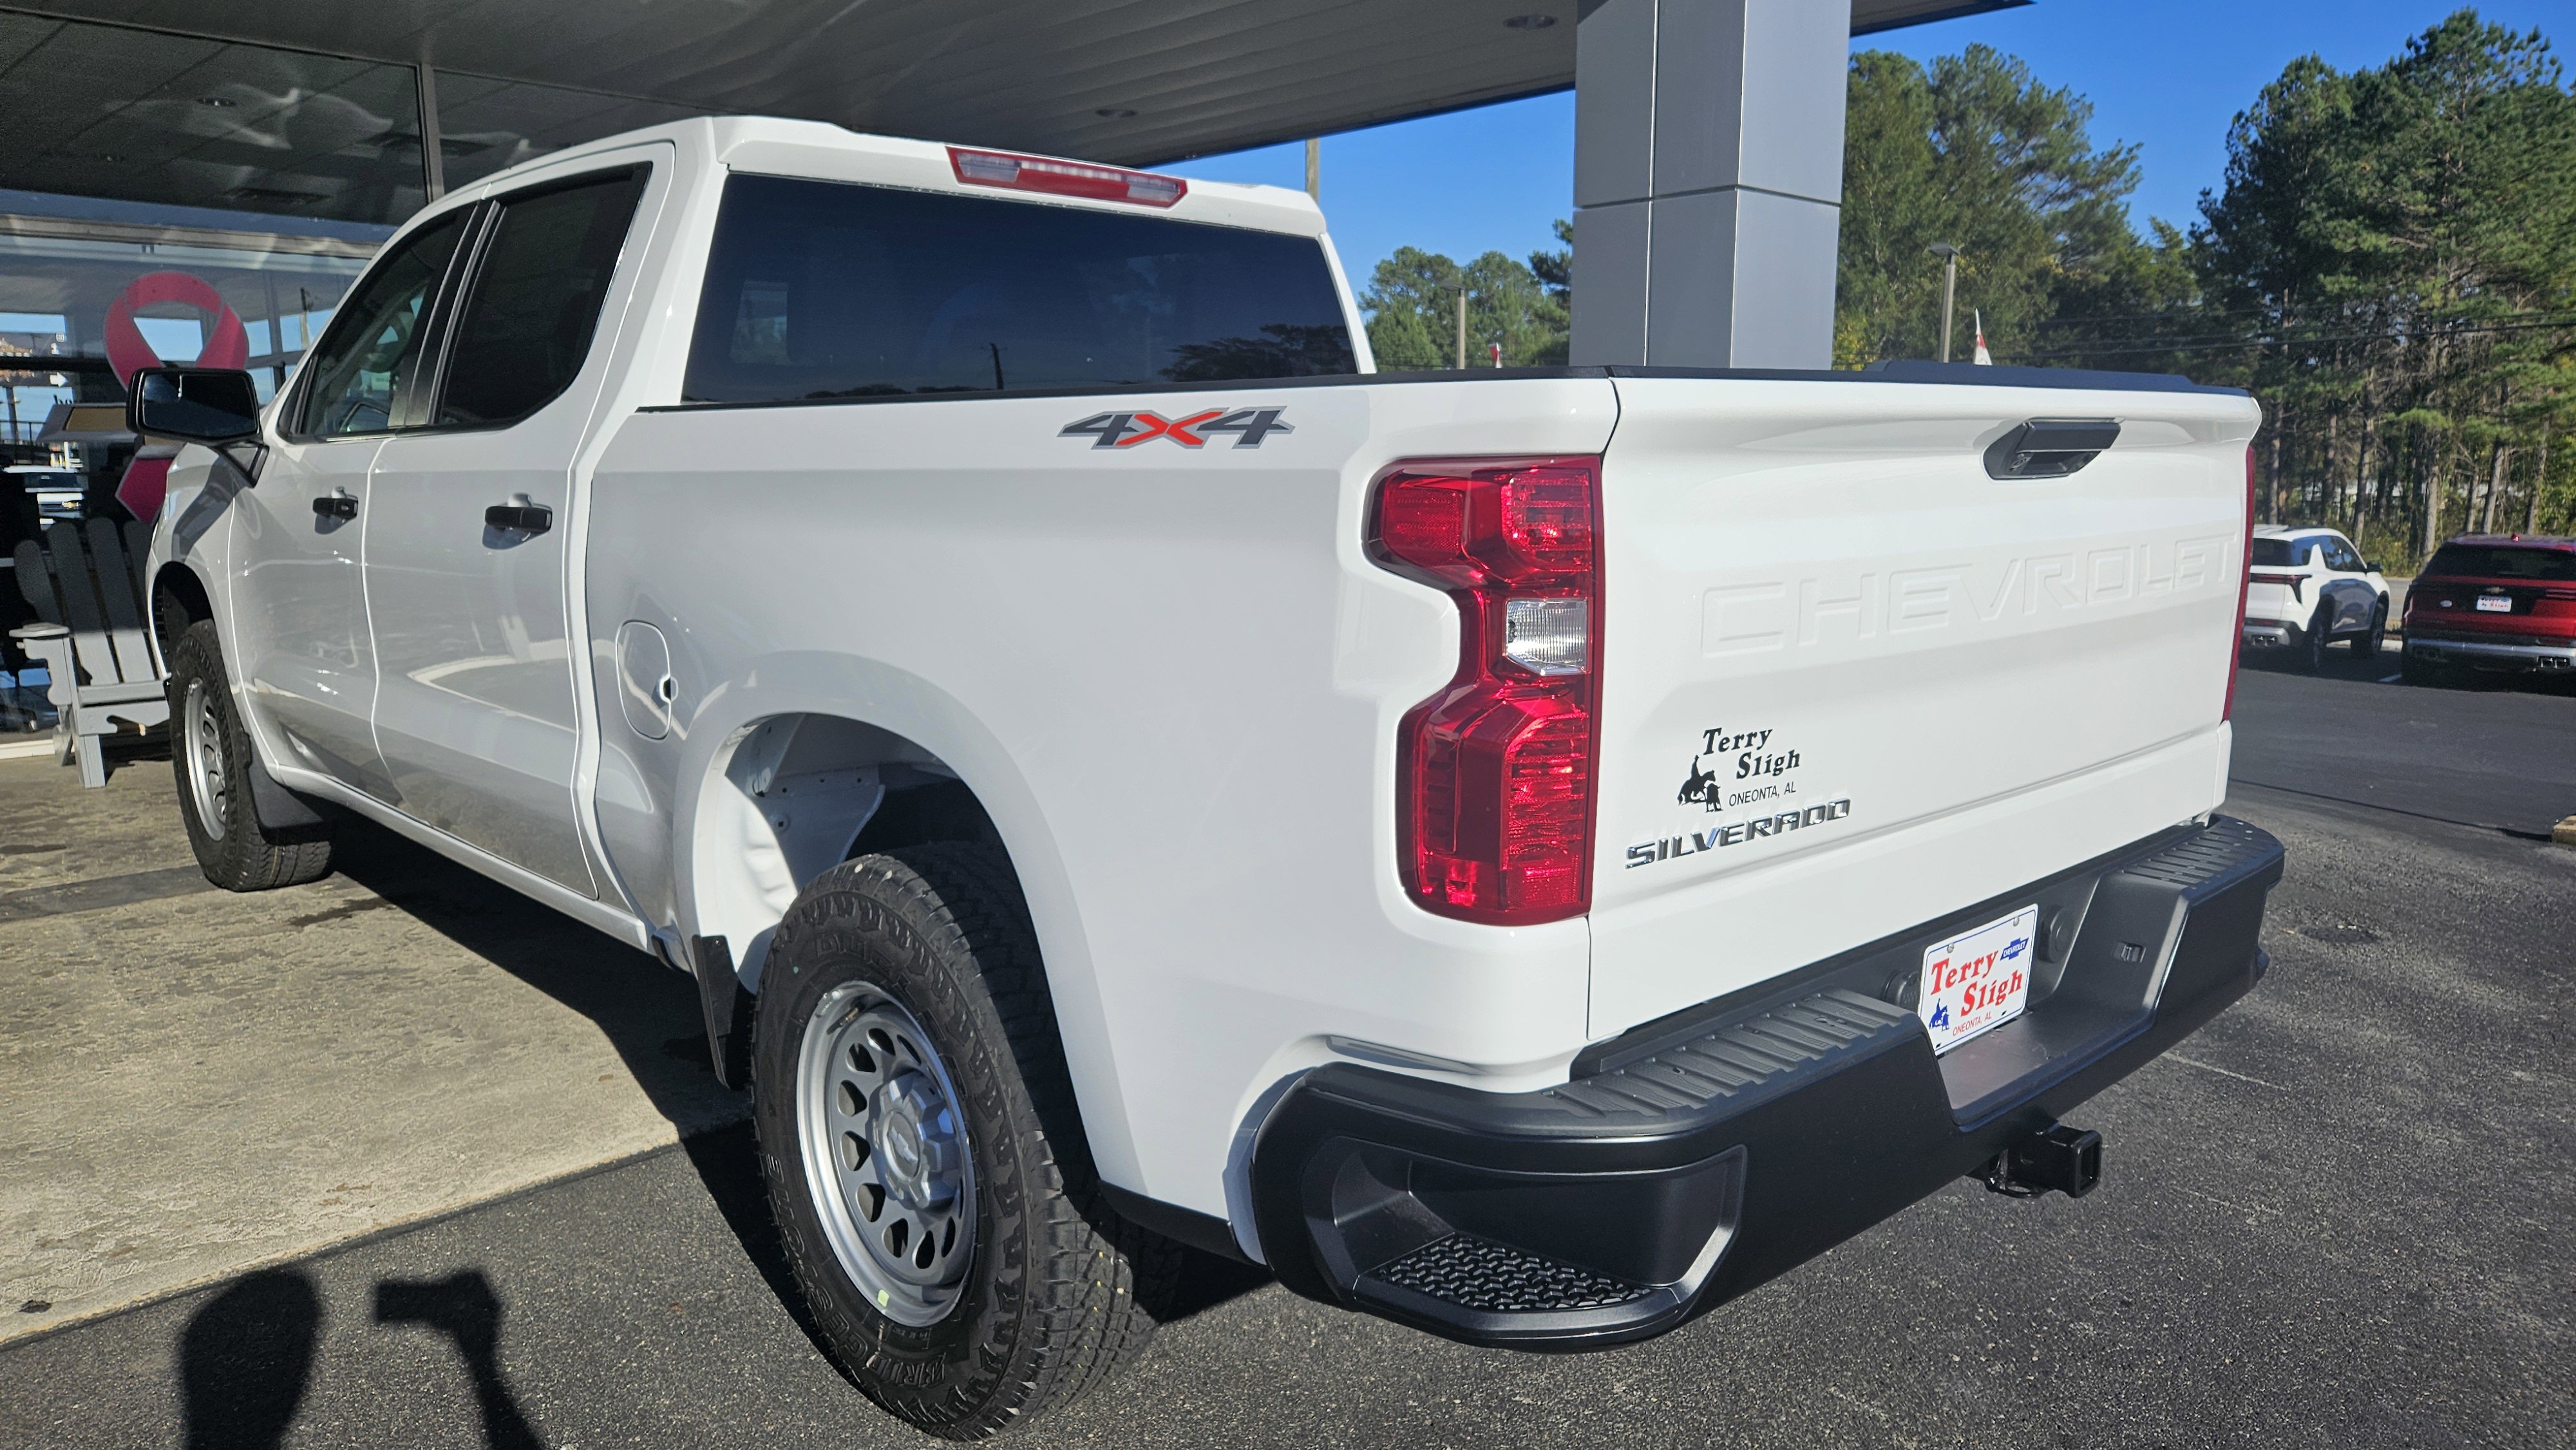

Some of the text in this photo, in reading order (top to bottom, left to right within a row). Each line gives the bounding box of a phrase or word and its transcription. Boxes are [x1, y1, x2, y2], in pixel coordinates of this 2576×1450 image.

[1700, 532, 2239, 659] CHEVROLET
[1702, 727, 1773, 755] Terry
[1736, 749, 1801, 780] Sligh
[1728, 781, 1797, 807] ONEONTA, AL
[1625, 796, 1851, 869] SILVERADO
[2003, 940, 2026, 958] CHEVROLET
[1930, 950, 1999, 995] Terry
[1960, 969, 2023, 1017] Sligh
[1952, 1012, 1992, 1037] ONEONTA, AL
